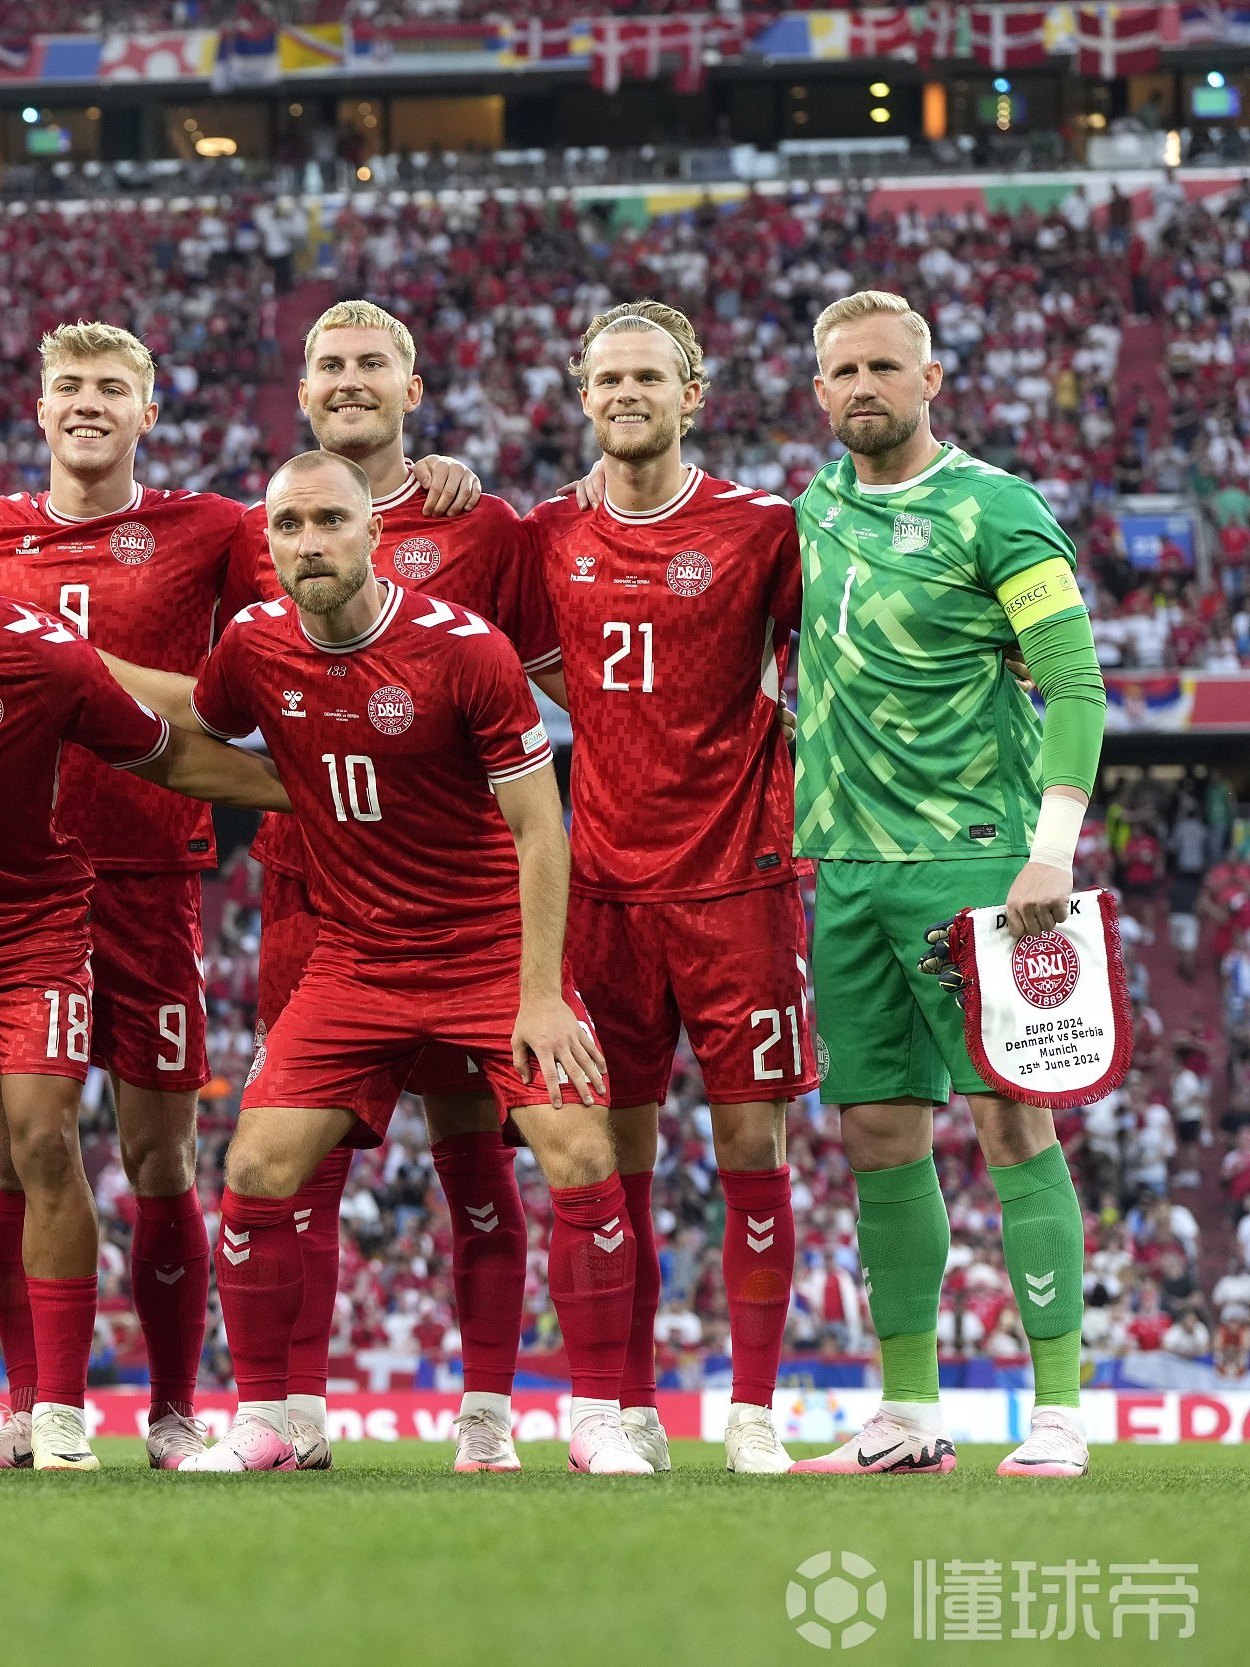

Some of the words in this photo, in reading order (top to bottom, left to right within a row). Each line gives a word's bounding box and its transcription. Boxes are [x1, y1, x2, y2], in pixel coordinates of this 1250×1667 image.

[119, 537, 146, 549] DBU
[901, 523, 922, 539] DBU
[404, 551, 431, 563] DBU
[676, 567, 703, 579] DBU
[60, 584, 89, 639] 9
[839, 566, 857, 635] 1
[1006, 584, 1048, 616] RESPECT
[602, 622, 654, 692] 21
[282, 708, 306, 718] hummel
[377, 703, 404, 717] DBU
[322, 754, 382, 821] 10
[1016, 955, 1035, 1000] DANSK
[1025, 953, 1066, 979] DBU
[1038, 992, 1063, 1005] 1889
[44, 990, 89, 1063] 18
[157, 1004, 186, 1071] 9
[1026, 1022, 1054, 1035] EURO
[1057, 1017, 1083, 1030] 2024
[751, 1006, 801, 1080] 21
[1006, 1034, 1054, 1051] Denmark
[1057, 1033, 1068, 1041] vs
[1072, 1027, 1104, 1039] Serbia
[1040, 1043, 1078, 1058] Munich
[1019, 1062, 1040, 1075] 25th
[1045, 1060, 1071, 1070] June
[1073, 1053, 1100, 1065] 2024
